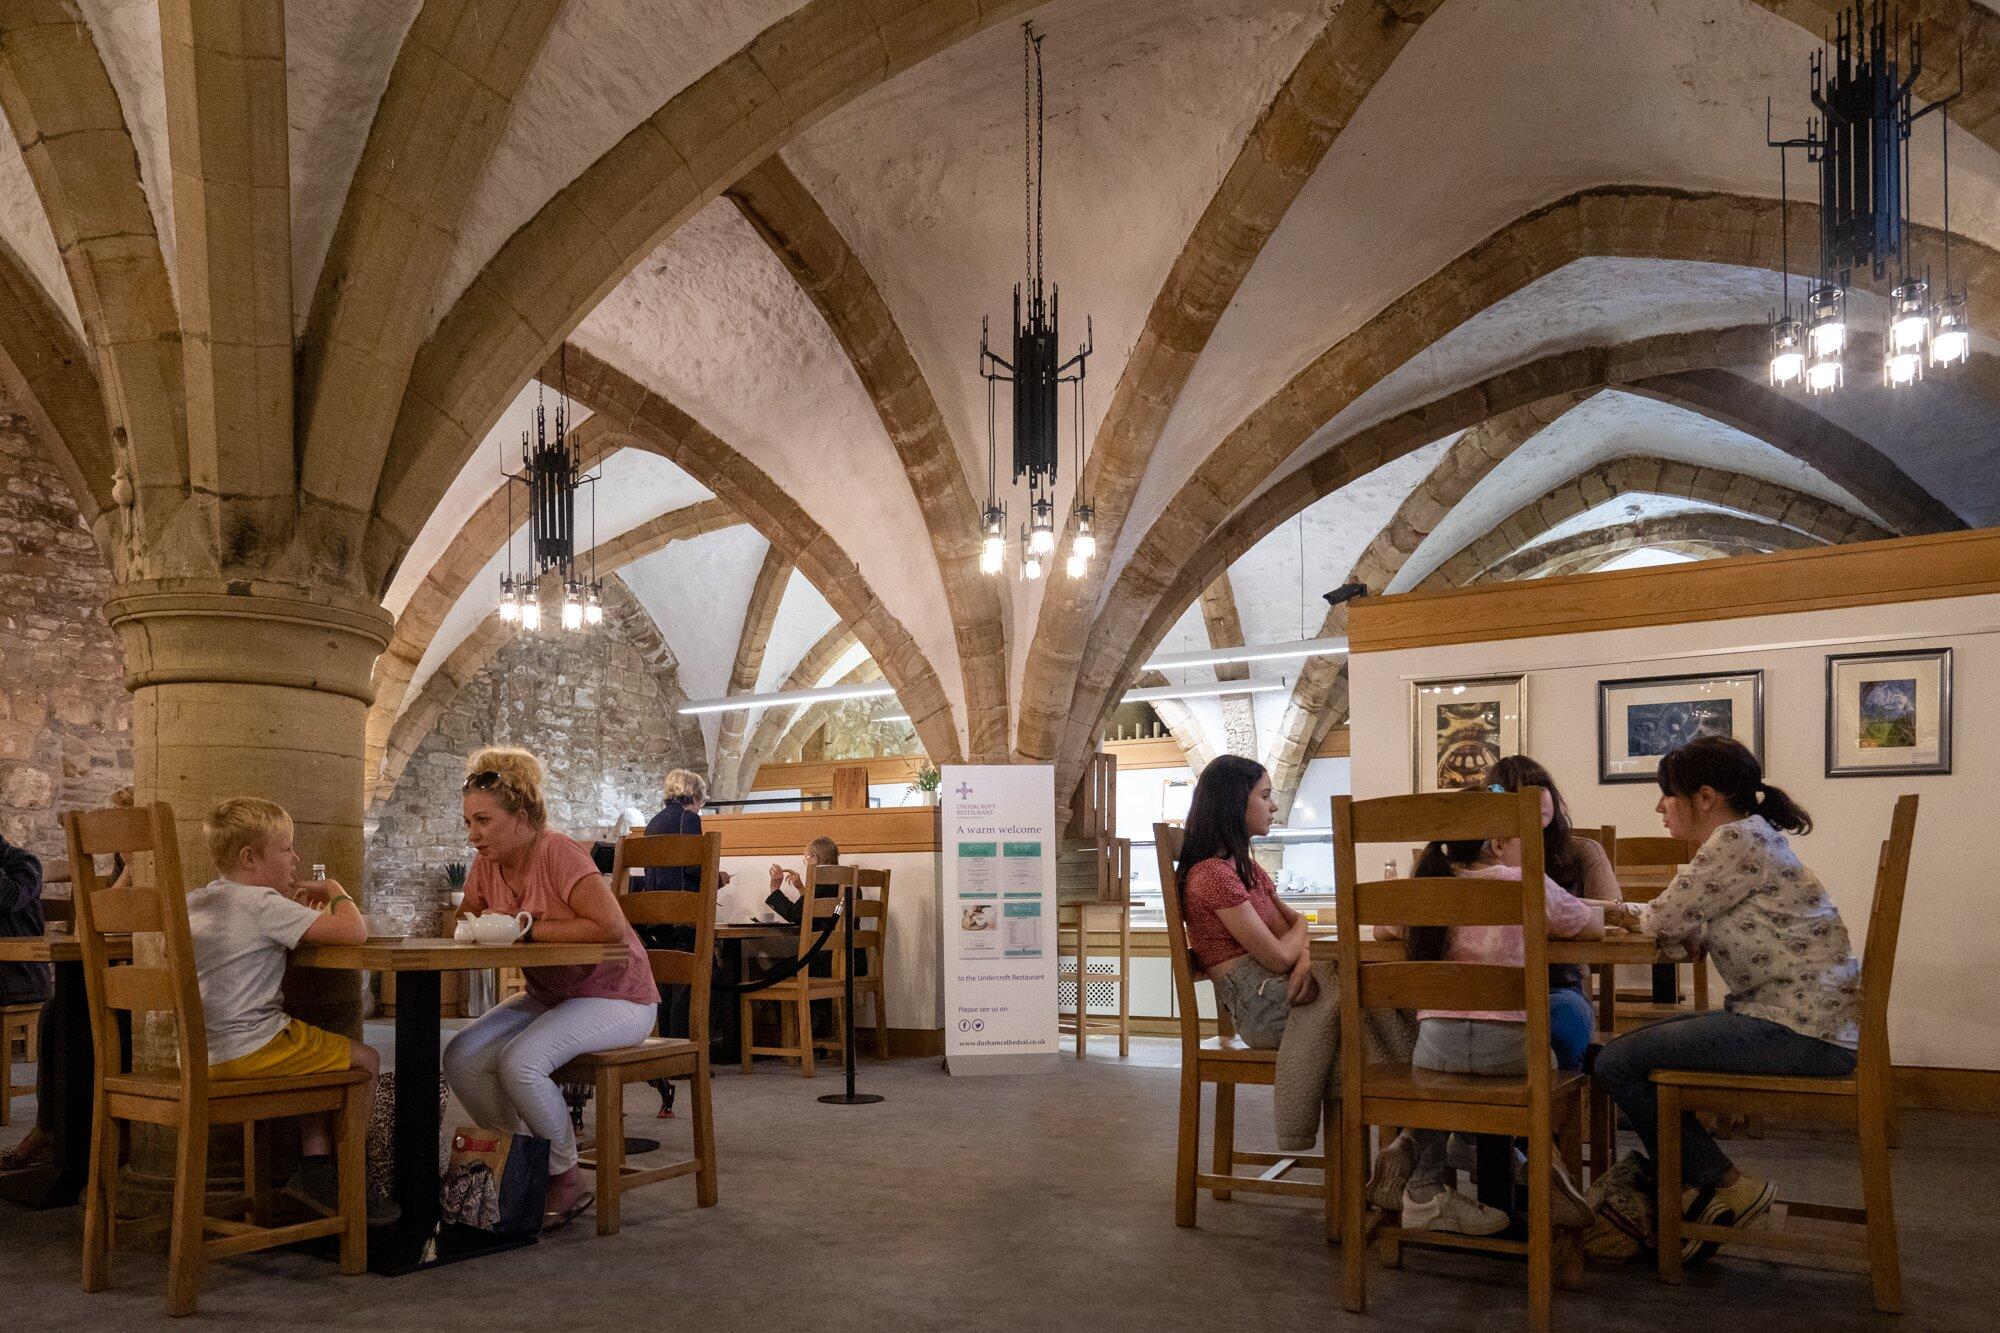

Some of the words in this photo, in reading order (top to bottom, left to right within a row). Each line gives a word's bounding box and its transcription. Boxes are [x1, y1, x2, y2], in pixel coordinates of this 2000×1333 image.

[956, 826, 964, 834] A
[967, 826, 995, 834] warm
[999, 825, 1042, 834] welcome
[959, 1039, 1046, 1047] www.durhamcathedral.co.uk
